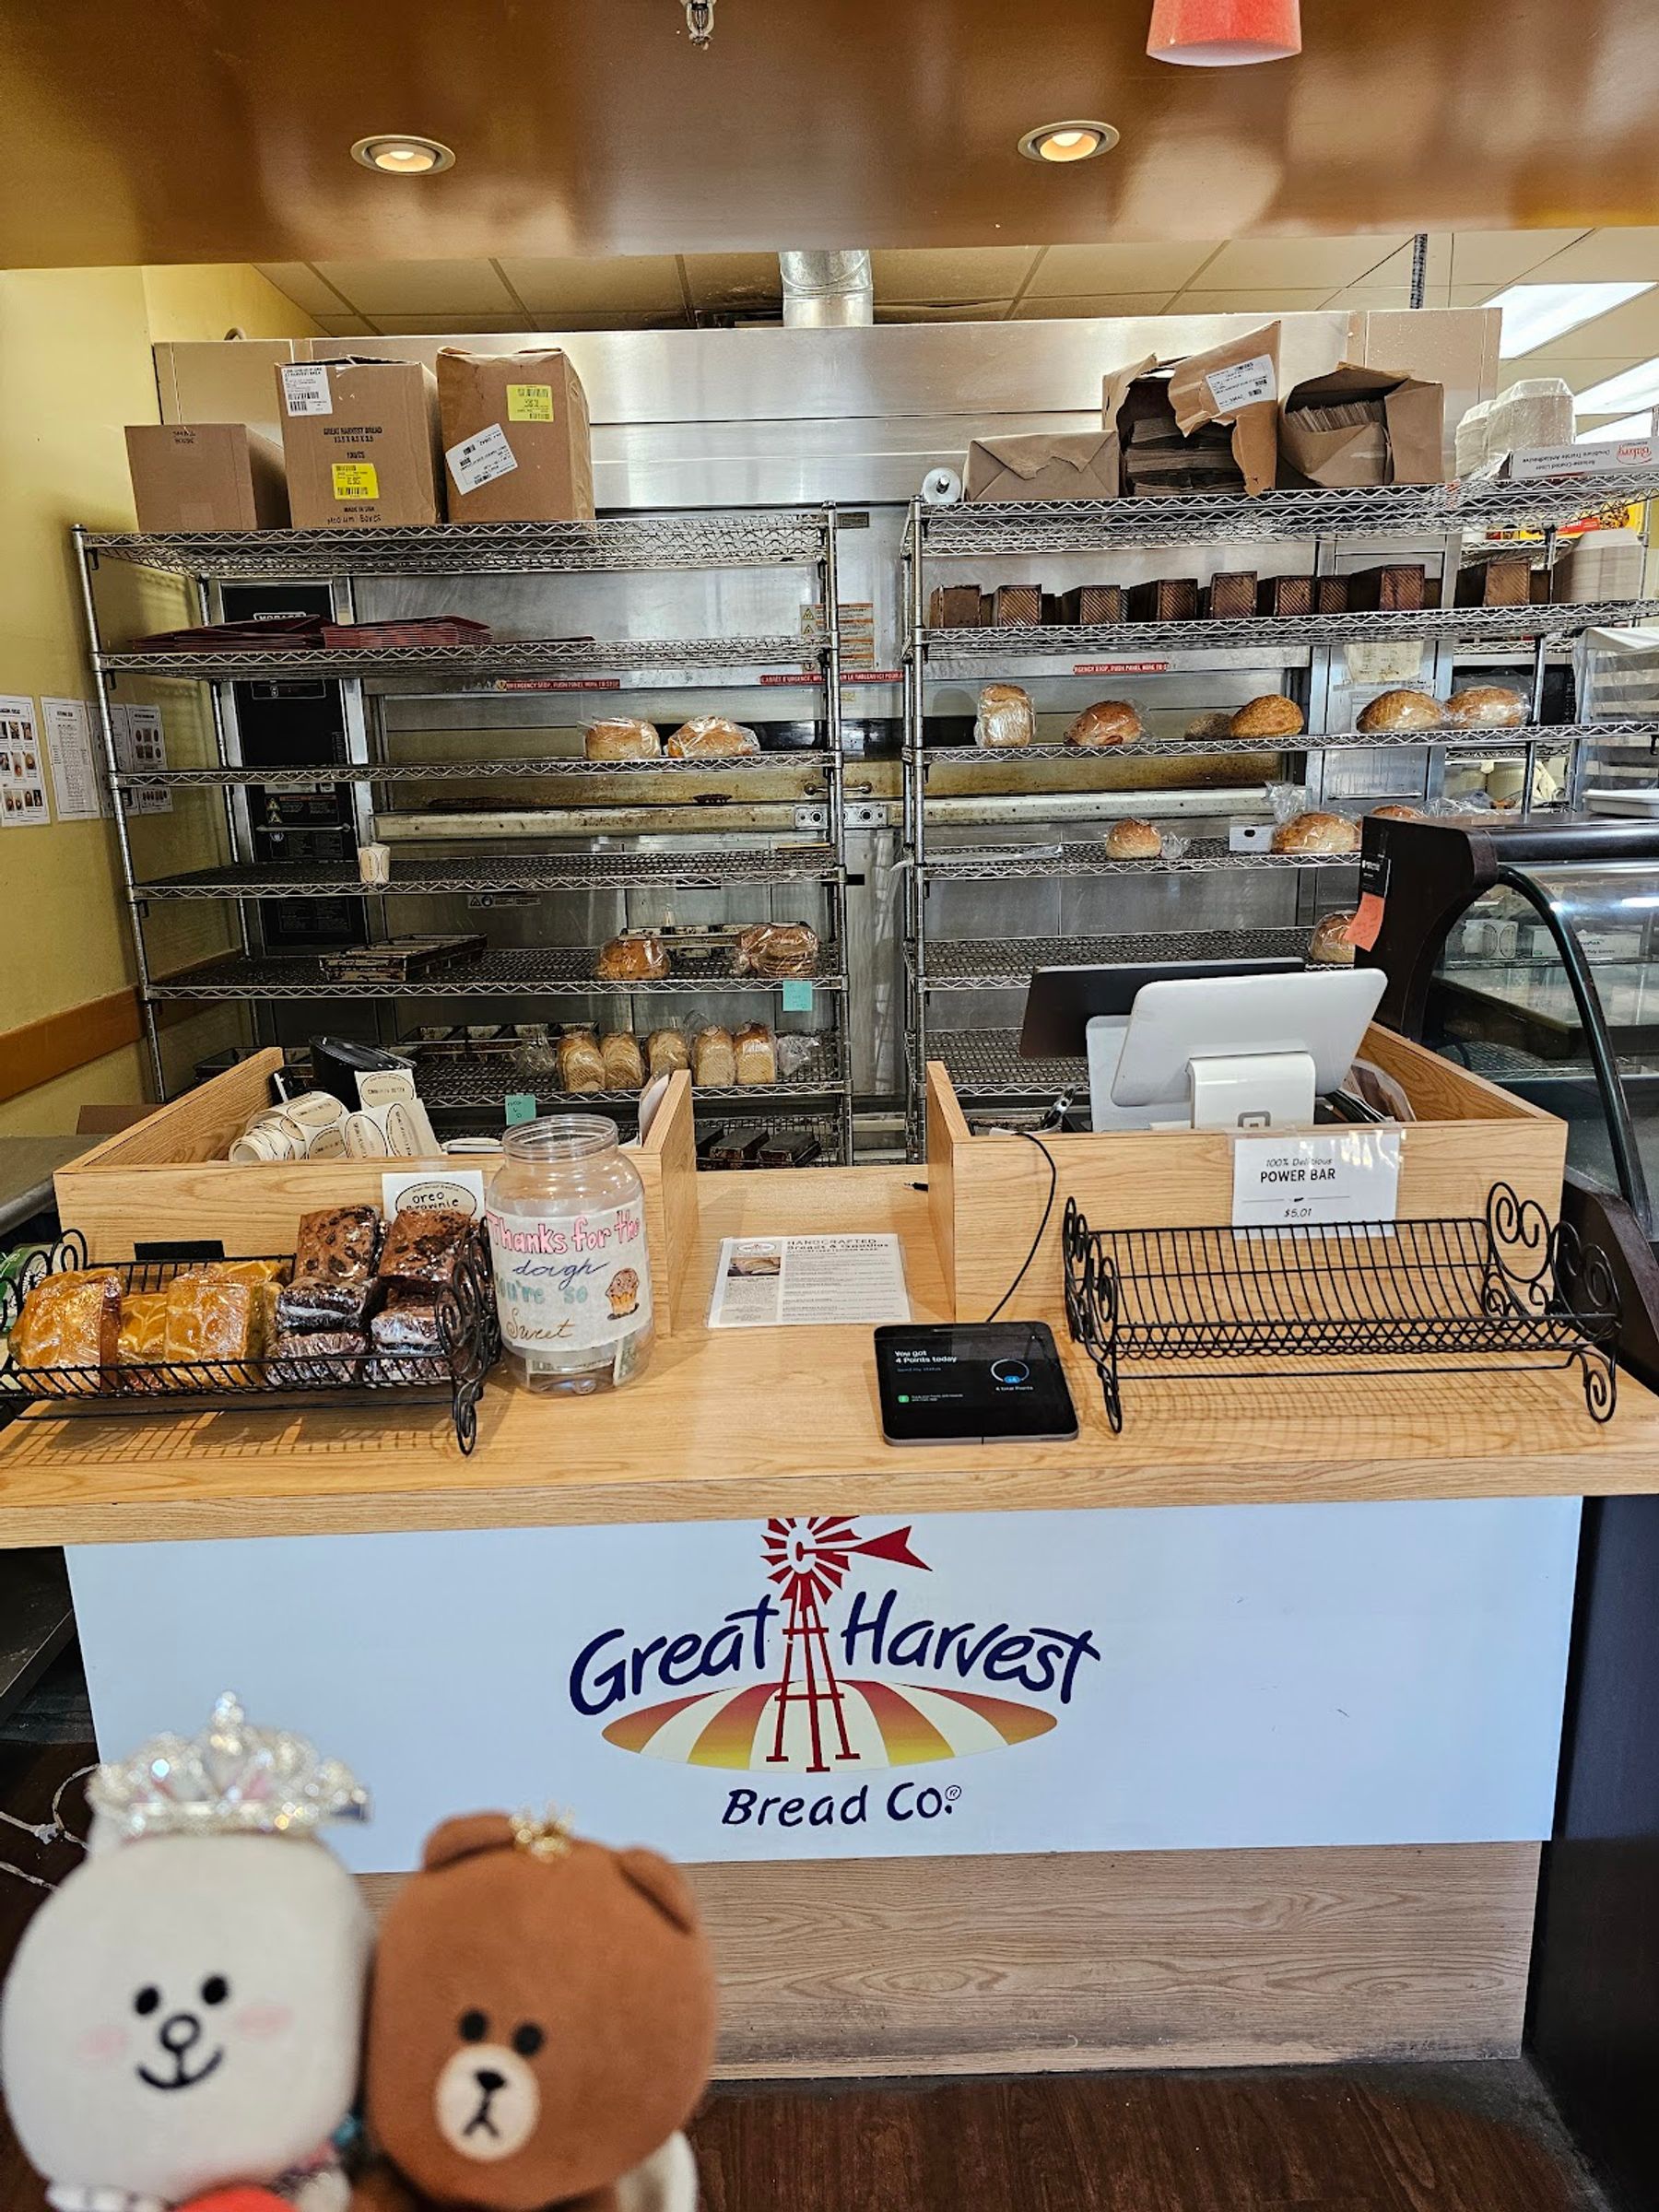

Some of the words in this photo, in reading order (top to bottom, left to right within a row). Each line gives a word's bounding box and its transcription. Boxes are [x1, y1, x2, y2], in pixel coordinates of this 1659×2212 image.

[1260, 1170, 1305, 1183] POWER
[1310, 1168, 1335, 1181] BAR
[1266, 1158, 1289, 1168] 100%
[1284, 1207, 1312, 1218] $5.01
[486, 1210, 568, 1254] Thanks
[572, 1215, 612, 1252] for
[512, 1258, 610, 1291] dough
[506, 1307, 576, 1340] Sweet
[570, 1594, 780, 1716] Great
[841, 1589, 1100, 1704] Harvest
[722, 1784, 868, 1828] Bread
